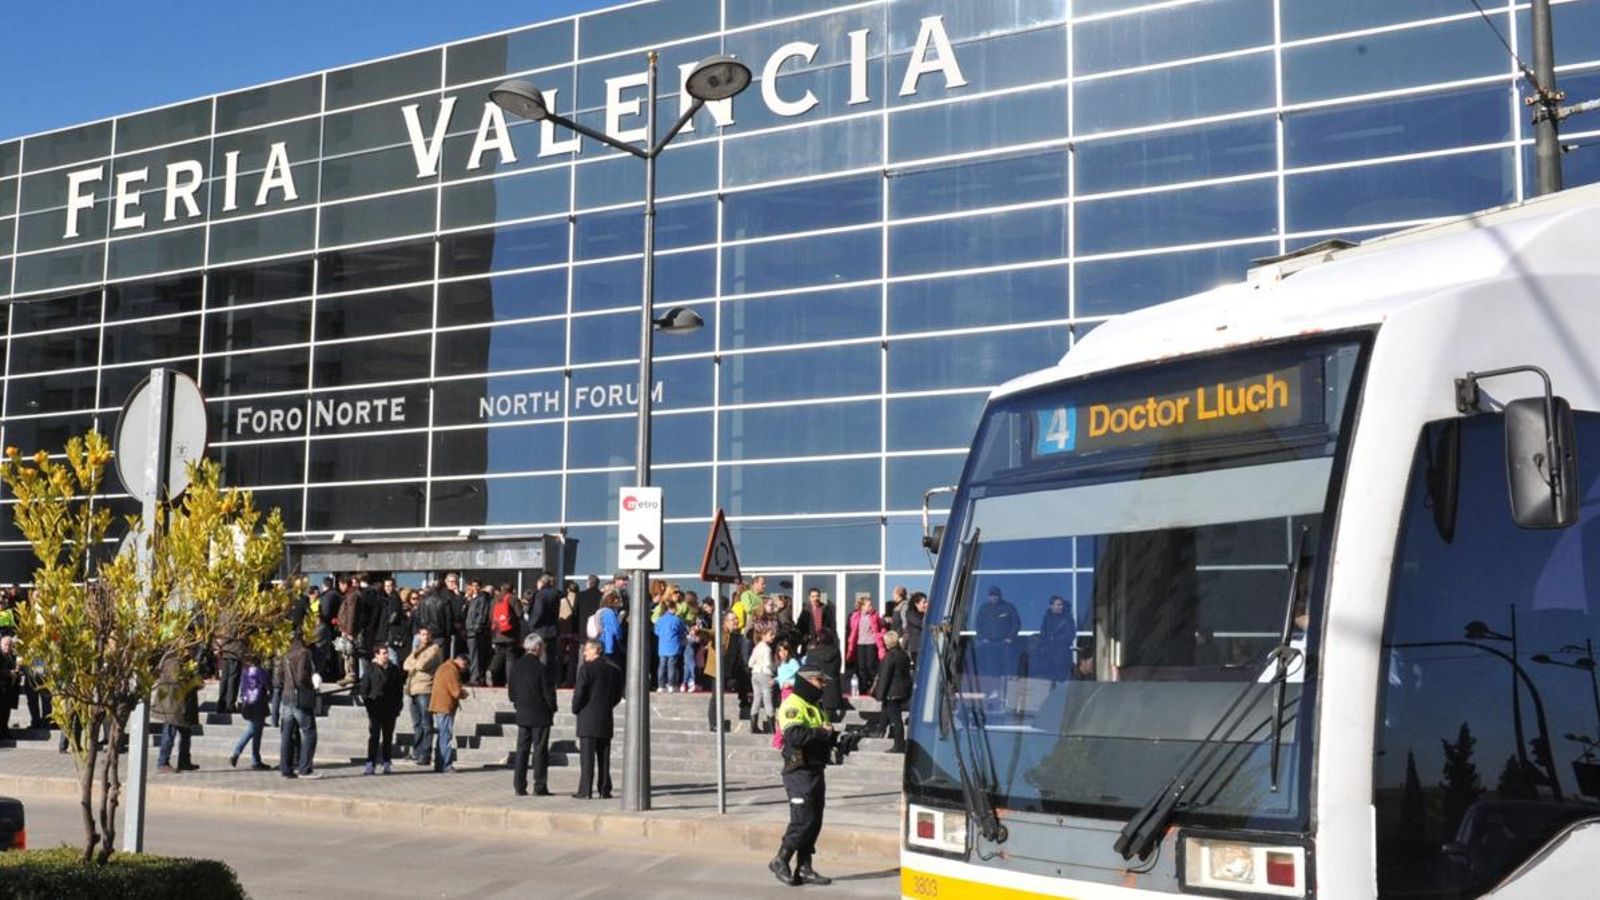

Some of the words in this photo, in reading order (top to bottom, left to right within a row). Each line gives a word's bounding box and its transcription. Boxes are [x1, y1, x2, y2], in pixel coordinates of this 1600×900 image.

[63, 141, 299, 239] FERIA
[401, 15, 968, 179] VALENCIA
[236, 407, 302, 434] FORO
[314, 396, 406, 428] NORTE
[479, 390, 560, 418] NORTH
[1045, 407, 1071, 450] 4
[1088, 397, 1190, 438] Doctor
[1196, 373, 1289, 421] Lluch
